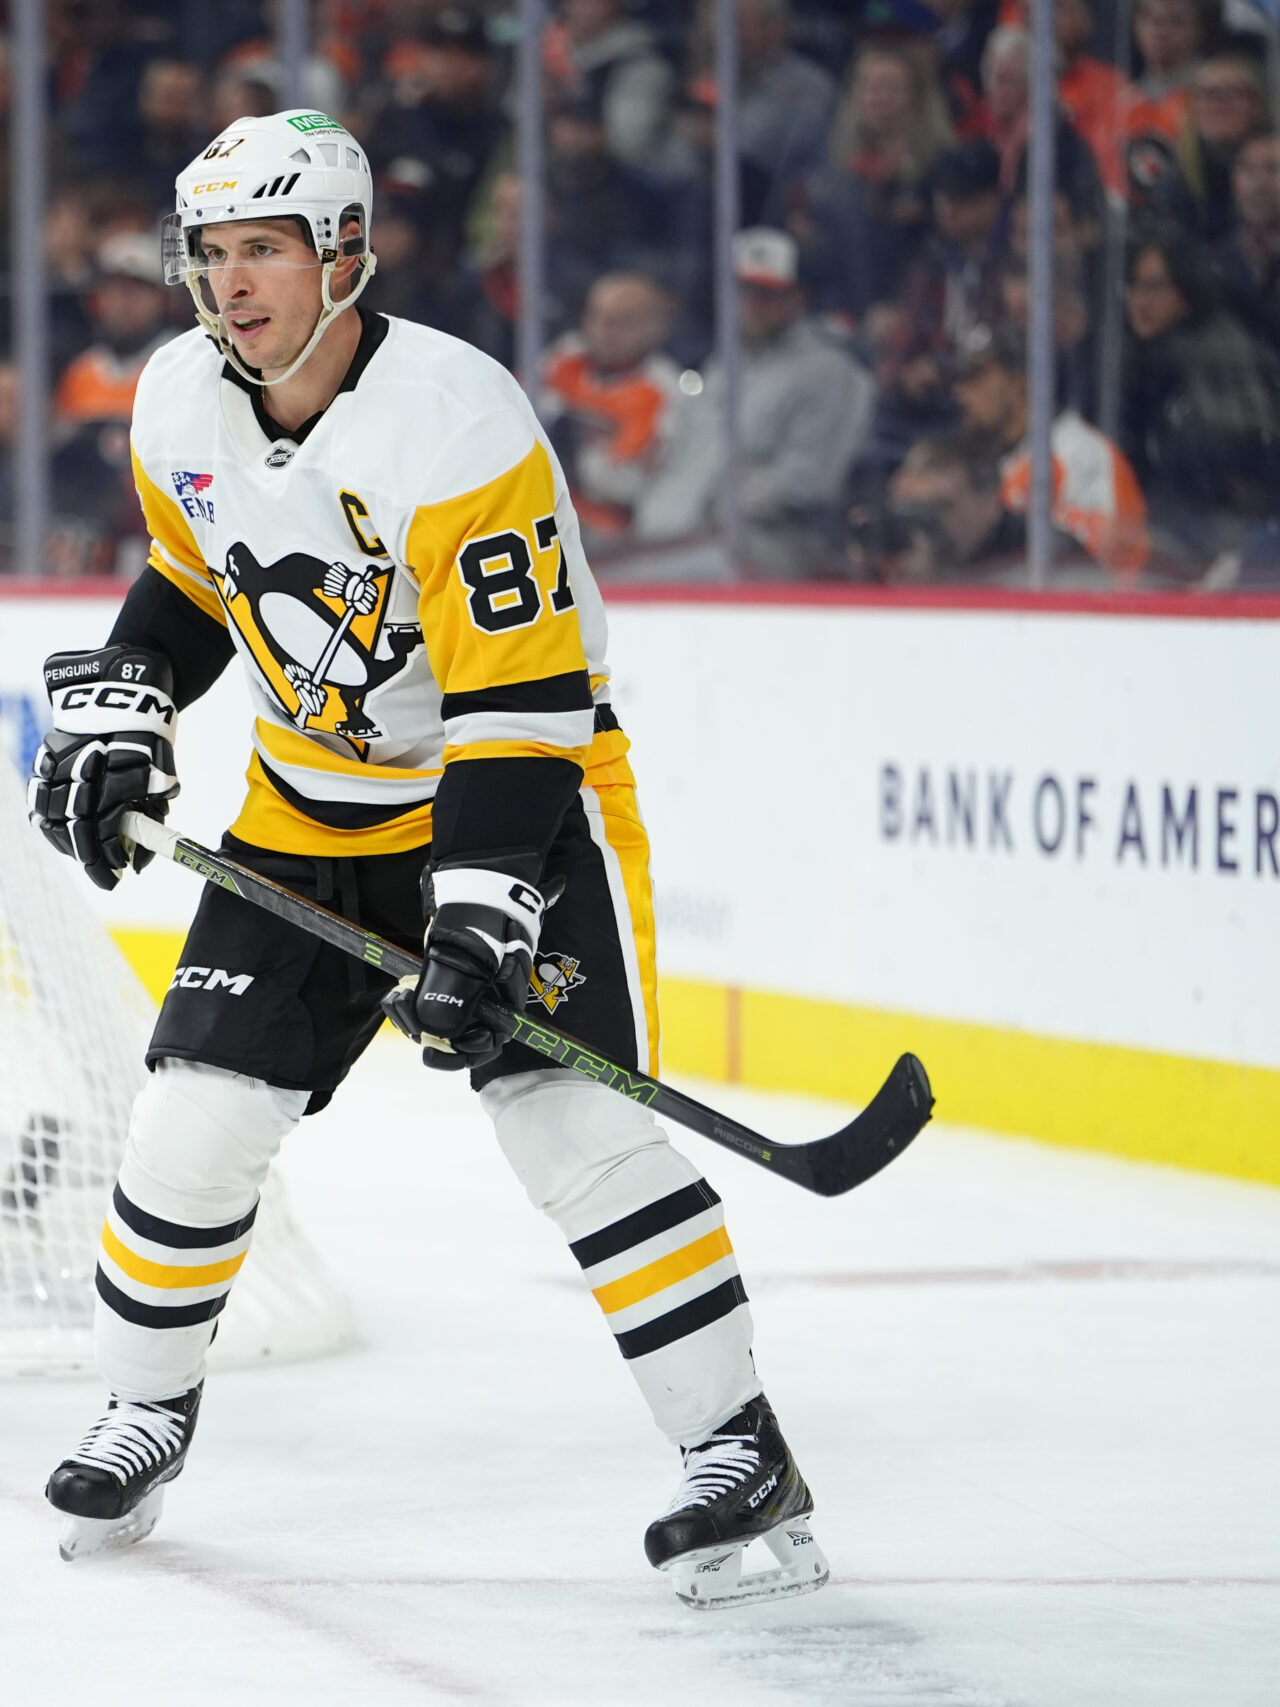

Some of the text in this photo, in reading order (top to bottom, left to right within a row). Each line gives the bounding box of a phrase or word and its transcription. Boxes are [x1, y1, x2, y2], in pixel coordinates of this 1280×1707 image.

[292, 115, 337, 130] MSA
[193, 181, 238, 194] CCM
[339, 489, 389, 558] C
[457, 514, 578, 635] 87
[45, 661, 146, 683] PENGUINS 87
[60, 683, 174, 725] CCM
[880, 762, 1280, 879] BANK OF AMER
[180, 854, 227, 884] CCM
[168, 966, 255, 996] CCM
[424, 992, 464, 1008] CCM
[513, 1014, 659, 1107] CCM
[748, 1474, 778, 1509] CCM
[792, 1536, 814, 1546] CCM
